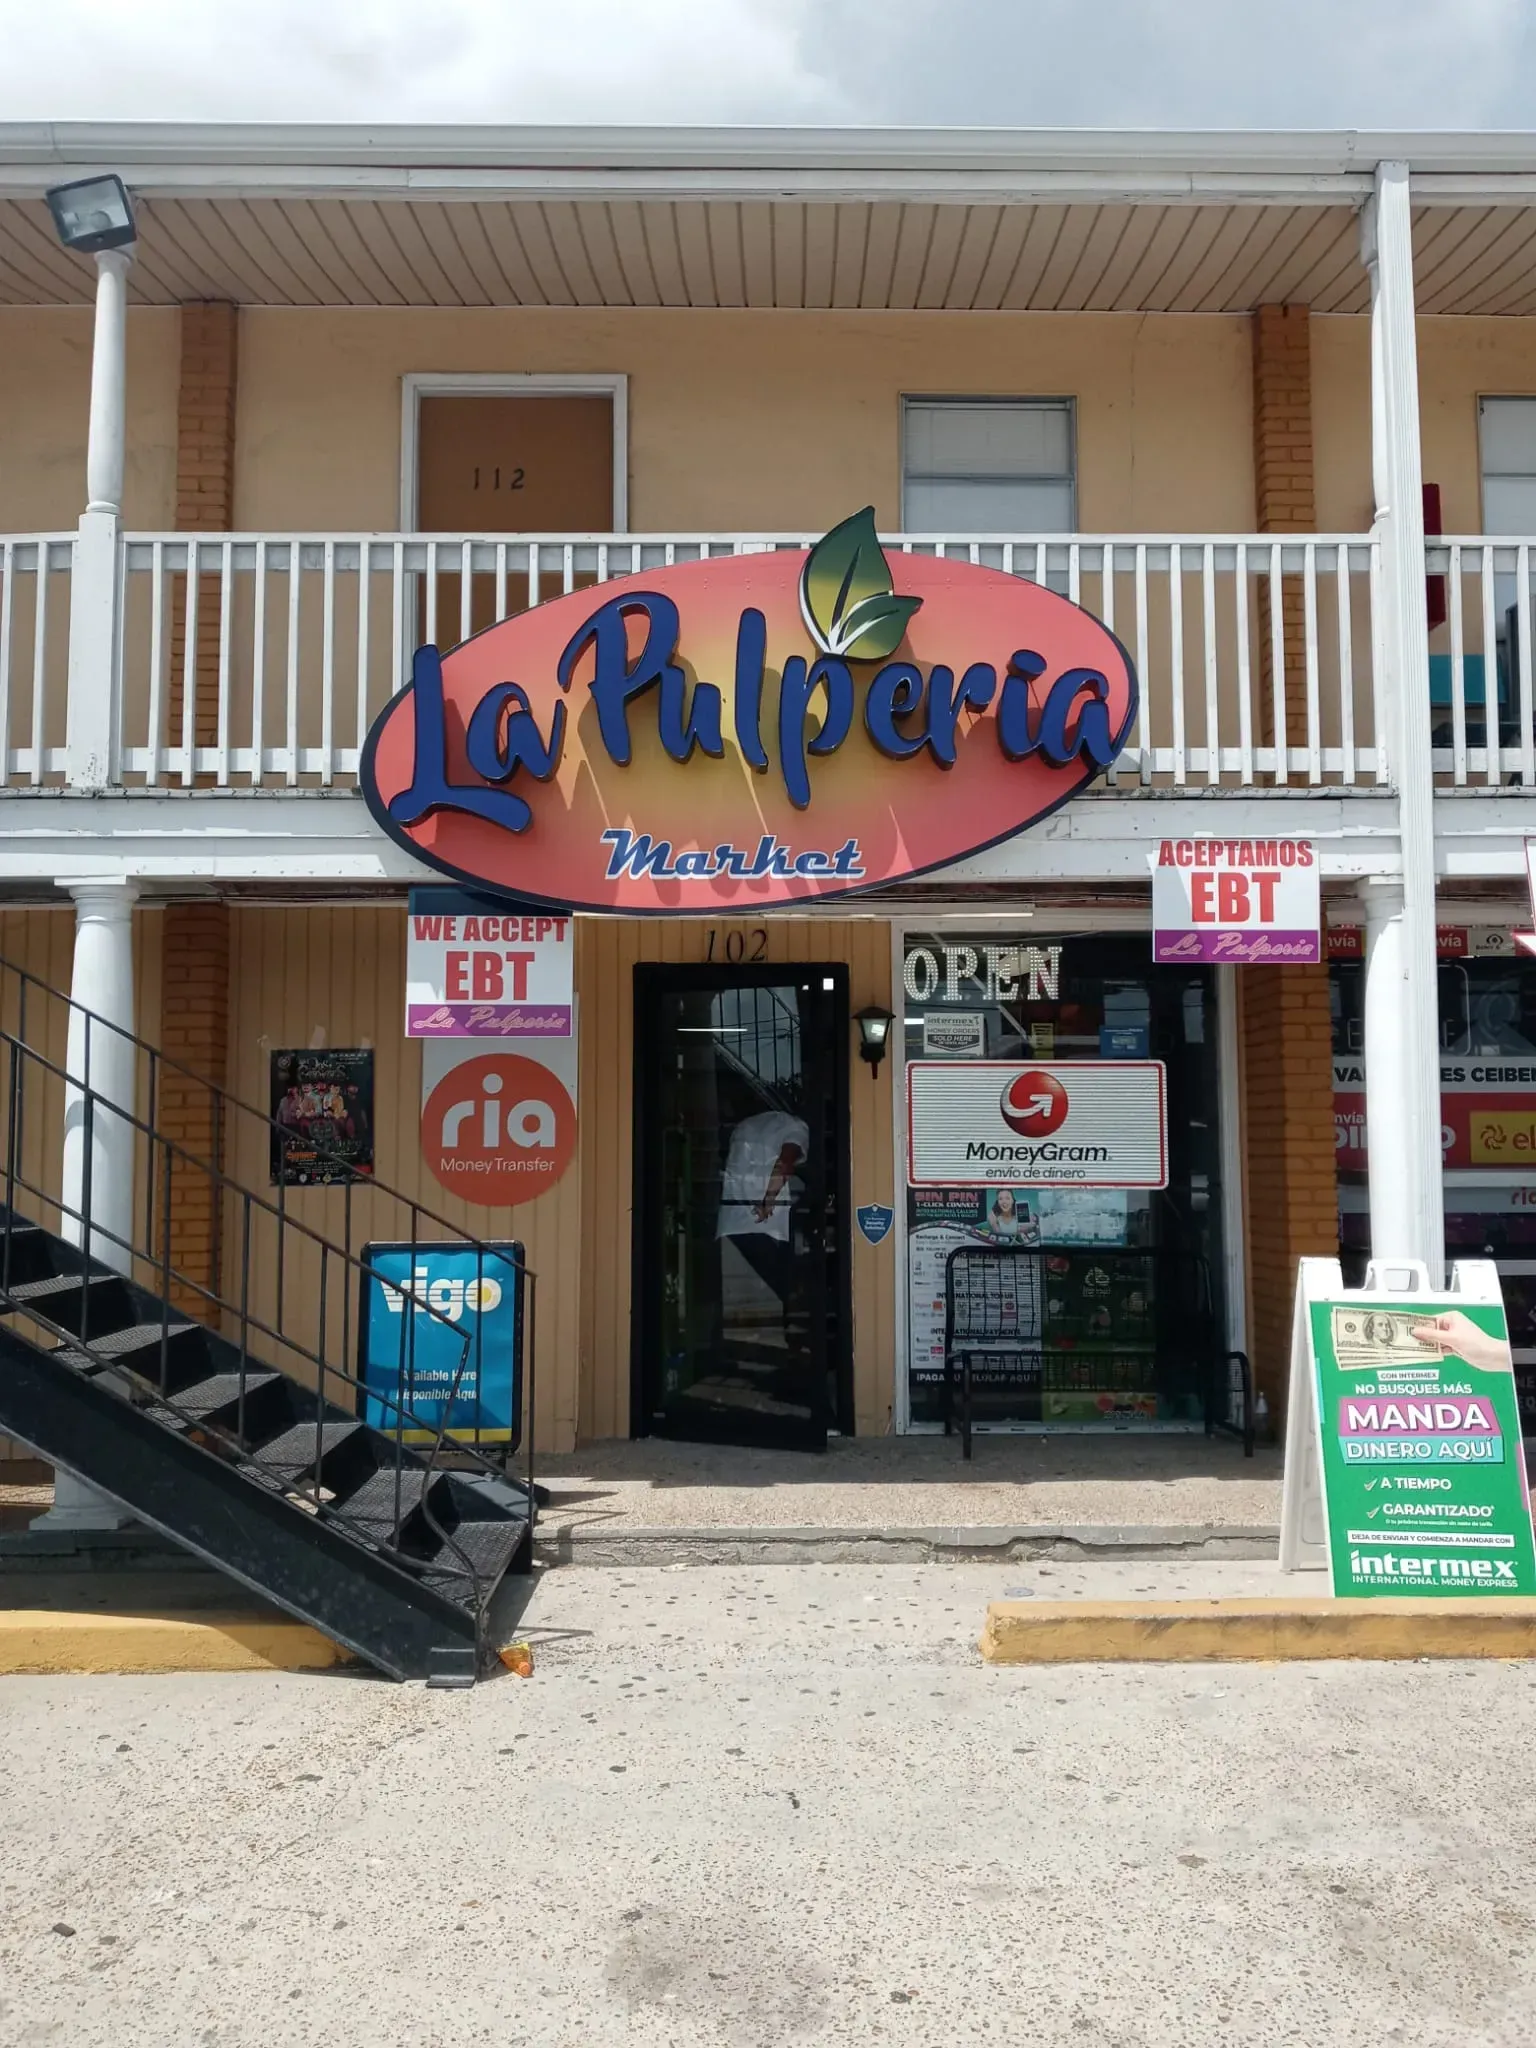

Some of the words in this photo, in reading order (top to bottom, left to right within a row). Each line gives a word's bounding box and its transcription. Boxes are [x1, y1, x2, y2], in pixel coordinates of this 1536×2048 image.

[474, 466, 525, 490] 112
[389, 643, 566, 832] La
[557, 590, 1136, 810] Pulperia
[600, 827, 868, 881] Market
[1159, 840, 1313, 867] ACEPTAMOS
[1191, 872, 1281, 923] EBT
[413, 916, 457, 942] WE
[462, 916, 569, 942] ACCEPT
[705, 928, 768, 964] 102
[1160, 933, 1203, 956] La
[445, 951, 536, 1001] EBT
[903, 945, 1063, 1002] OPEN
[412, 1006, 456, 1030] La
[927, 1015, 974, 1025] intermex
[441, 1072, 557, 1149] ria
[441, 1157, 491, 1174] Money
[494, 1157, 555, 1172] Transfer
[966, 1142, 1107, 1166] MoneyGram
[1023, 1167, 1040, 1178] de
[1043, 1167, 1086, 1179] dinero
[915, 1192, 943, 1201] SIN
[948, 1192, 978, 1201] PIN
[380, 1267, 502, 1323] vigo
[1380, 1372, 1397, 1380] CON
[1399, 1371, 1438, 1379] INTERMEX
[1355, 1384, 1375, 1394] NO
[1378, 1384, 1440, 1396] BUSQUES
[1443, 1381, 1472, 1394] MÁS
[1347, 1403, 1491, 1431] MANDA
[1346, 1442, 1432, 1459] DINERO
[1438, 1437, 1495, 1460] AQUÍ
[1380, 1477, 1392, 1489] A
[1394, 1477, 1452, 1490] TIEMPO
[1352, 1533, 1370, 1541] DEJA
[1416, 1535, 1454, 1543] COMIENZA
[1350, 1550, 1516, 1578] intermex
[1352, 1576, 1439, 1586] INTERNATIONAL
[1441, 1577, 1476, 1587] MONEY
[1477, 1578, 1518, 1588] EXPRESS
